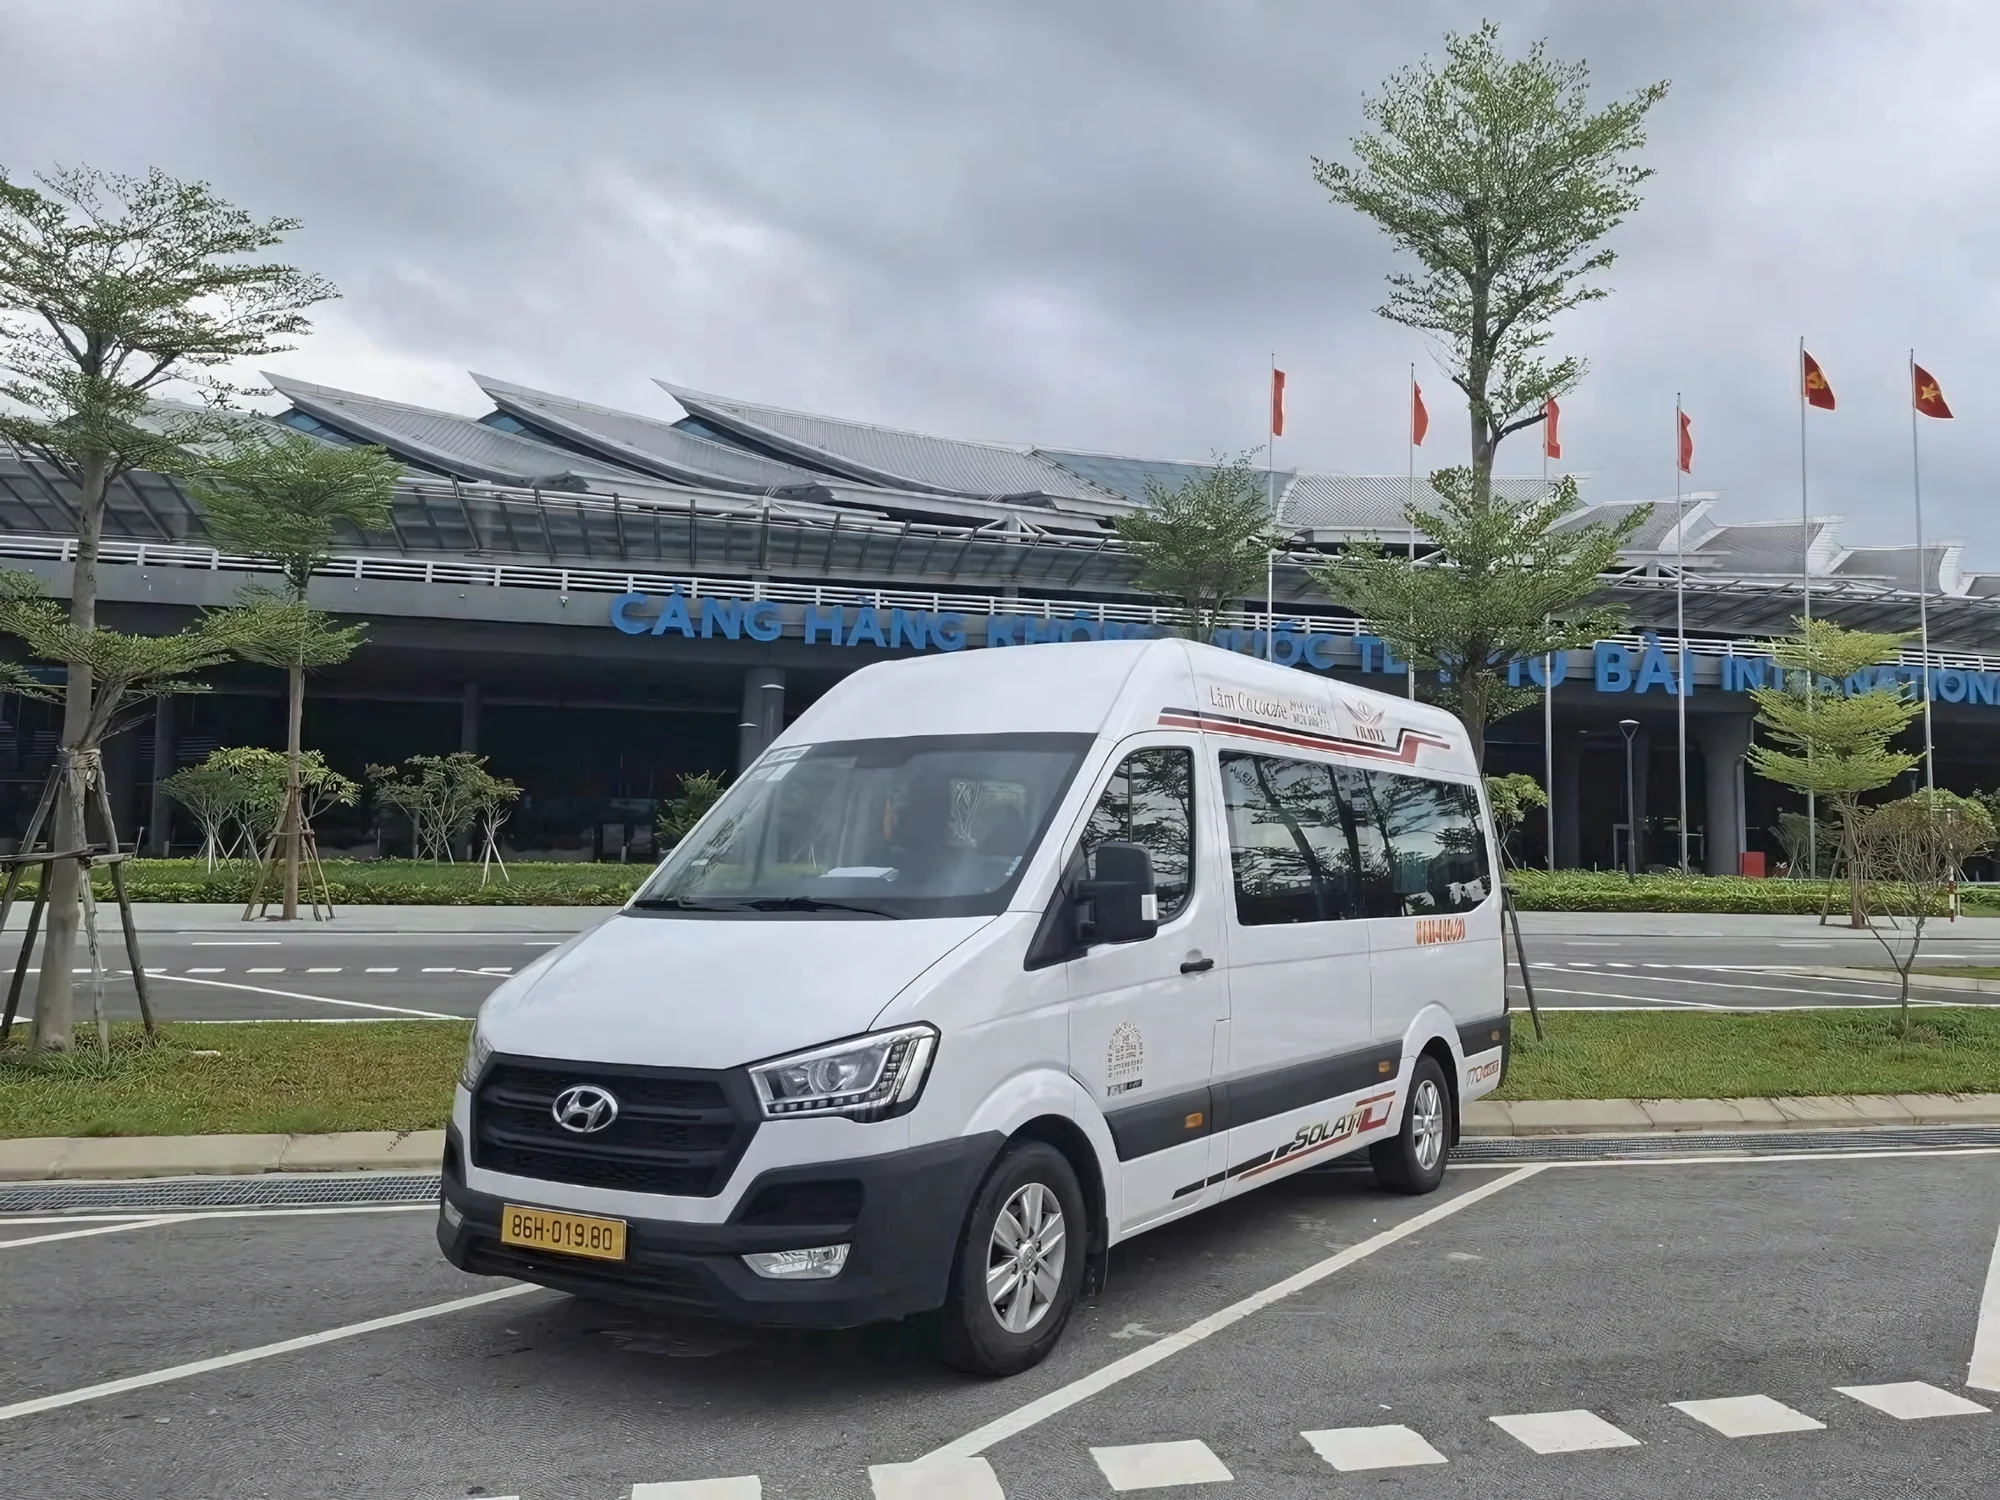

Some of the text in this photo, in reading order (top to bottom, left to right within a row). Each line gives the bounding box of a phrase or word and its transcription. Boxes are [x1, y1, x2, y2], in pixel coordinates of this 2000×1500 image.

[610, 584, 782, 641] CẢNG
[804, 596, 966, 651] HÀNG
[1594, 631, 1694, 697] BÀI
[1287, 1110, 1364, 1152] SOLATI
